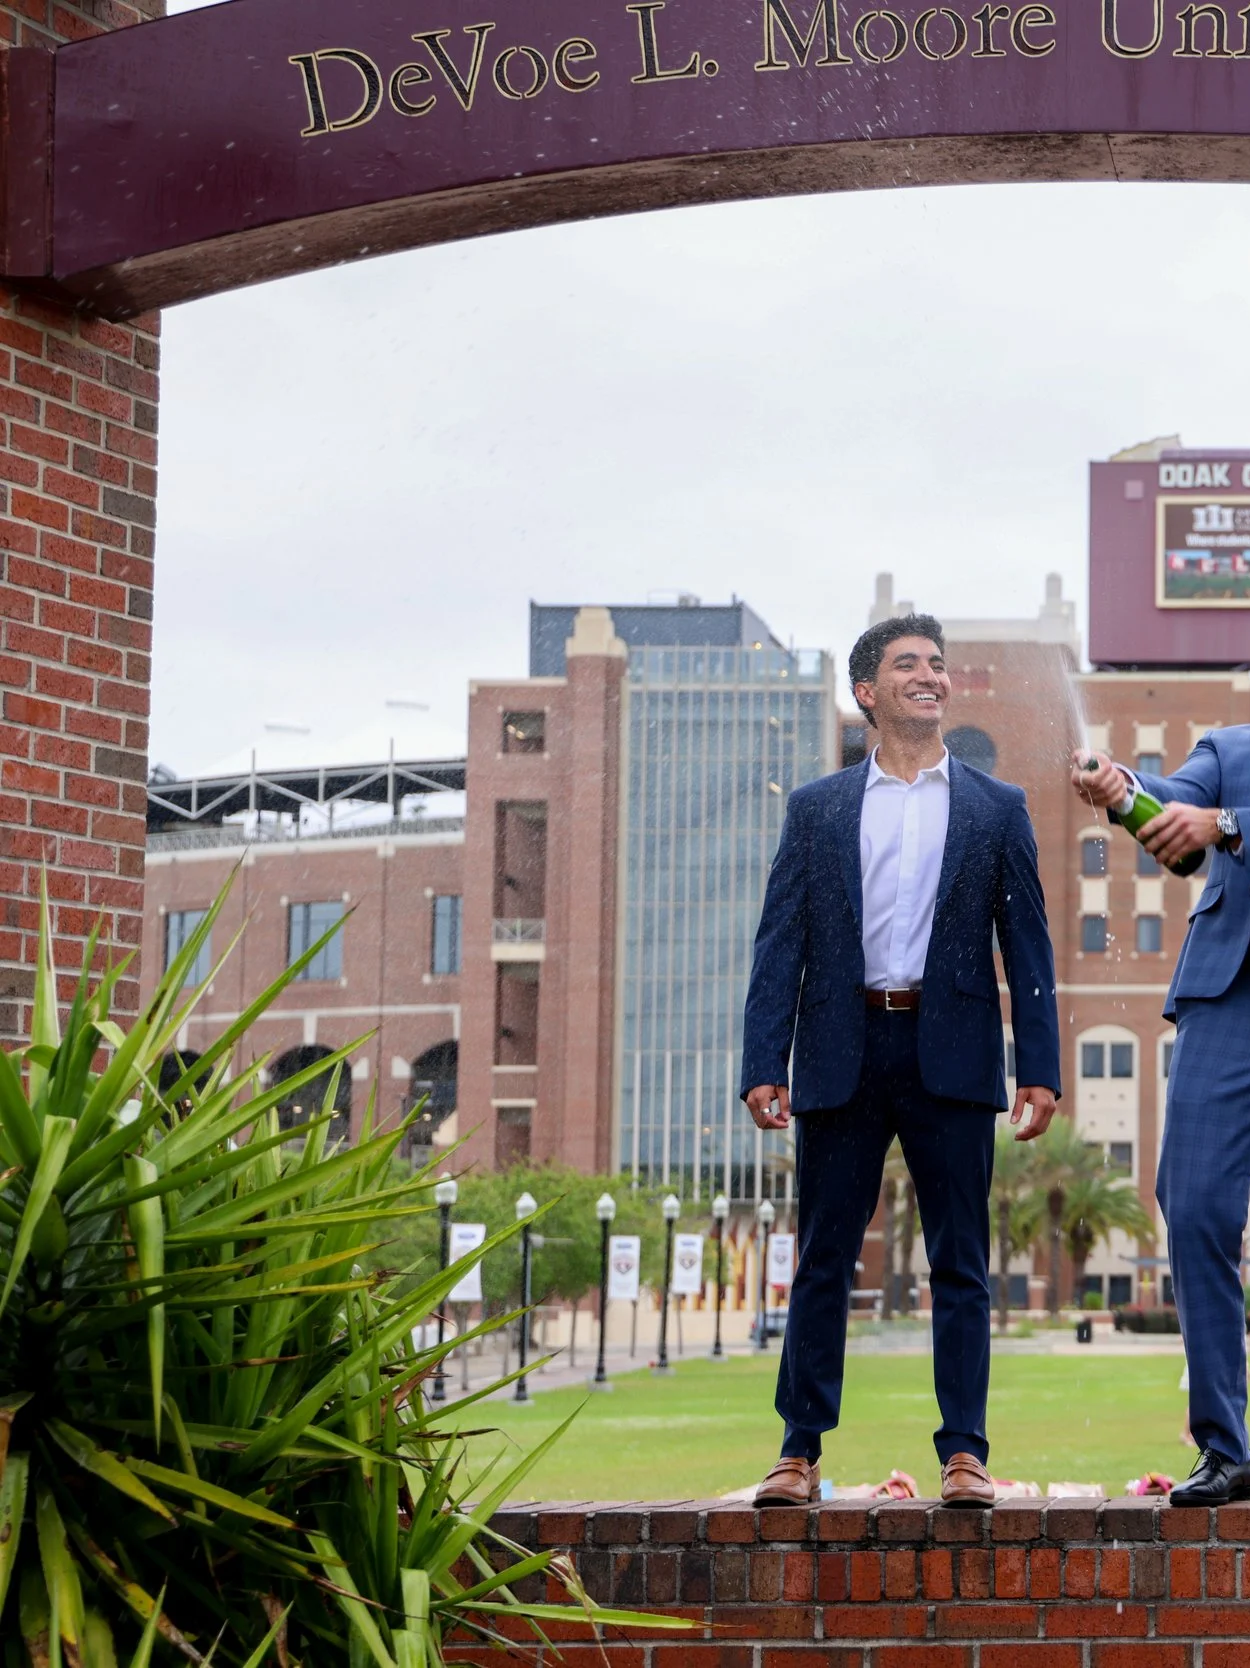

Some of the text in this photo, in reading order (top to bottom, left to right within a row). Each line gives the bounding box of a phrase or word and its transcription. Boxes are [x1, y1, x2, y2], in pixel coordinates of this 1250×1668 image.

[288, 22, 600, 137] DeVoe
[626, 2, 719, 83] L.
[754, 0, 1056, 71] Moore
[1159, 463, 1231, 488] DOAK
